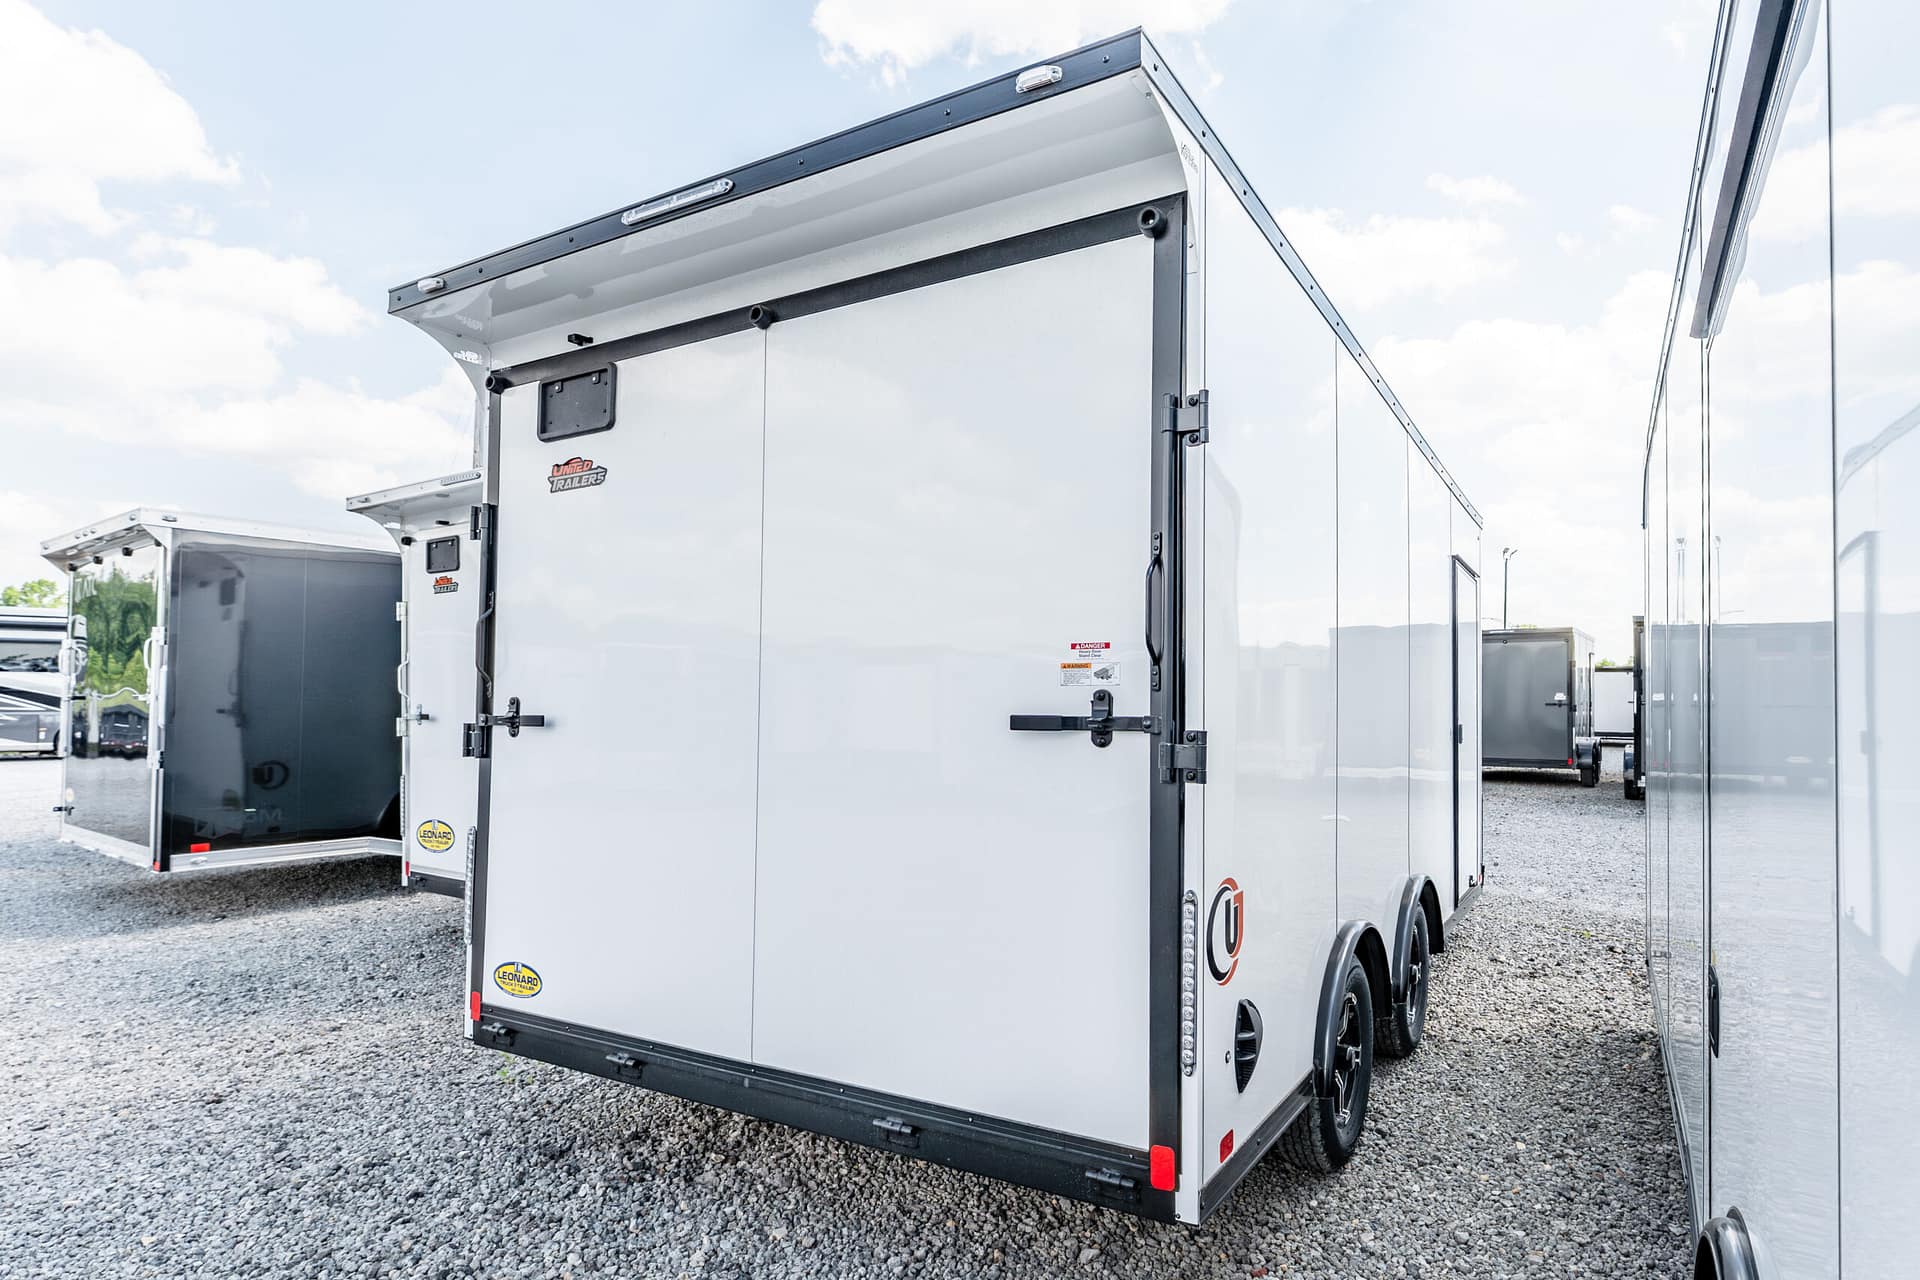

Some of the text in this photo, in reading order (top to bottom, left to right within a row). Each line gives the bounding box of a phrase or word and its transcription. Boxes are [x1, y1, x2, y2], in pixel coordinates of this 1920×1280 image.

[552, 460, 593, 477] UNITED
[551, 471, 606, 491] TRAILERS
[419, 830, 452, 840] LEONARD
[497, 970, 539, 987] LEONARD
[517, 983, 535, 991] TRAILER
